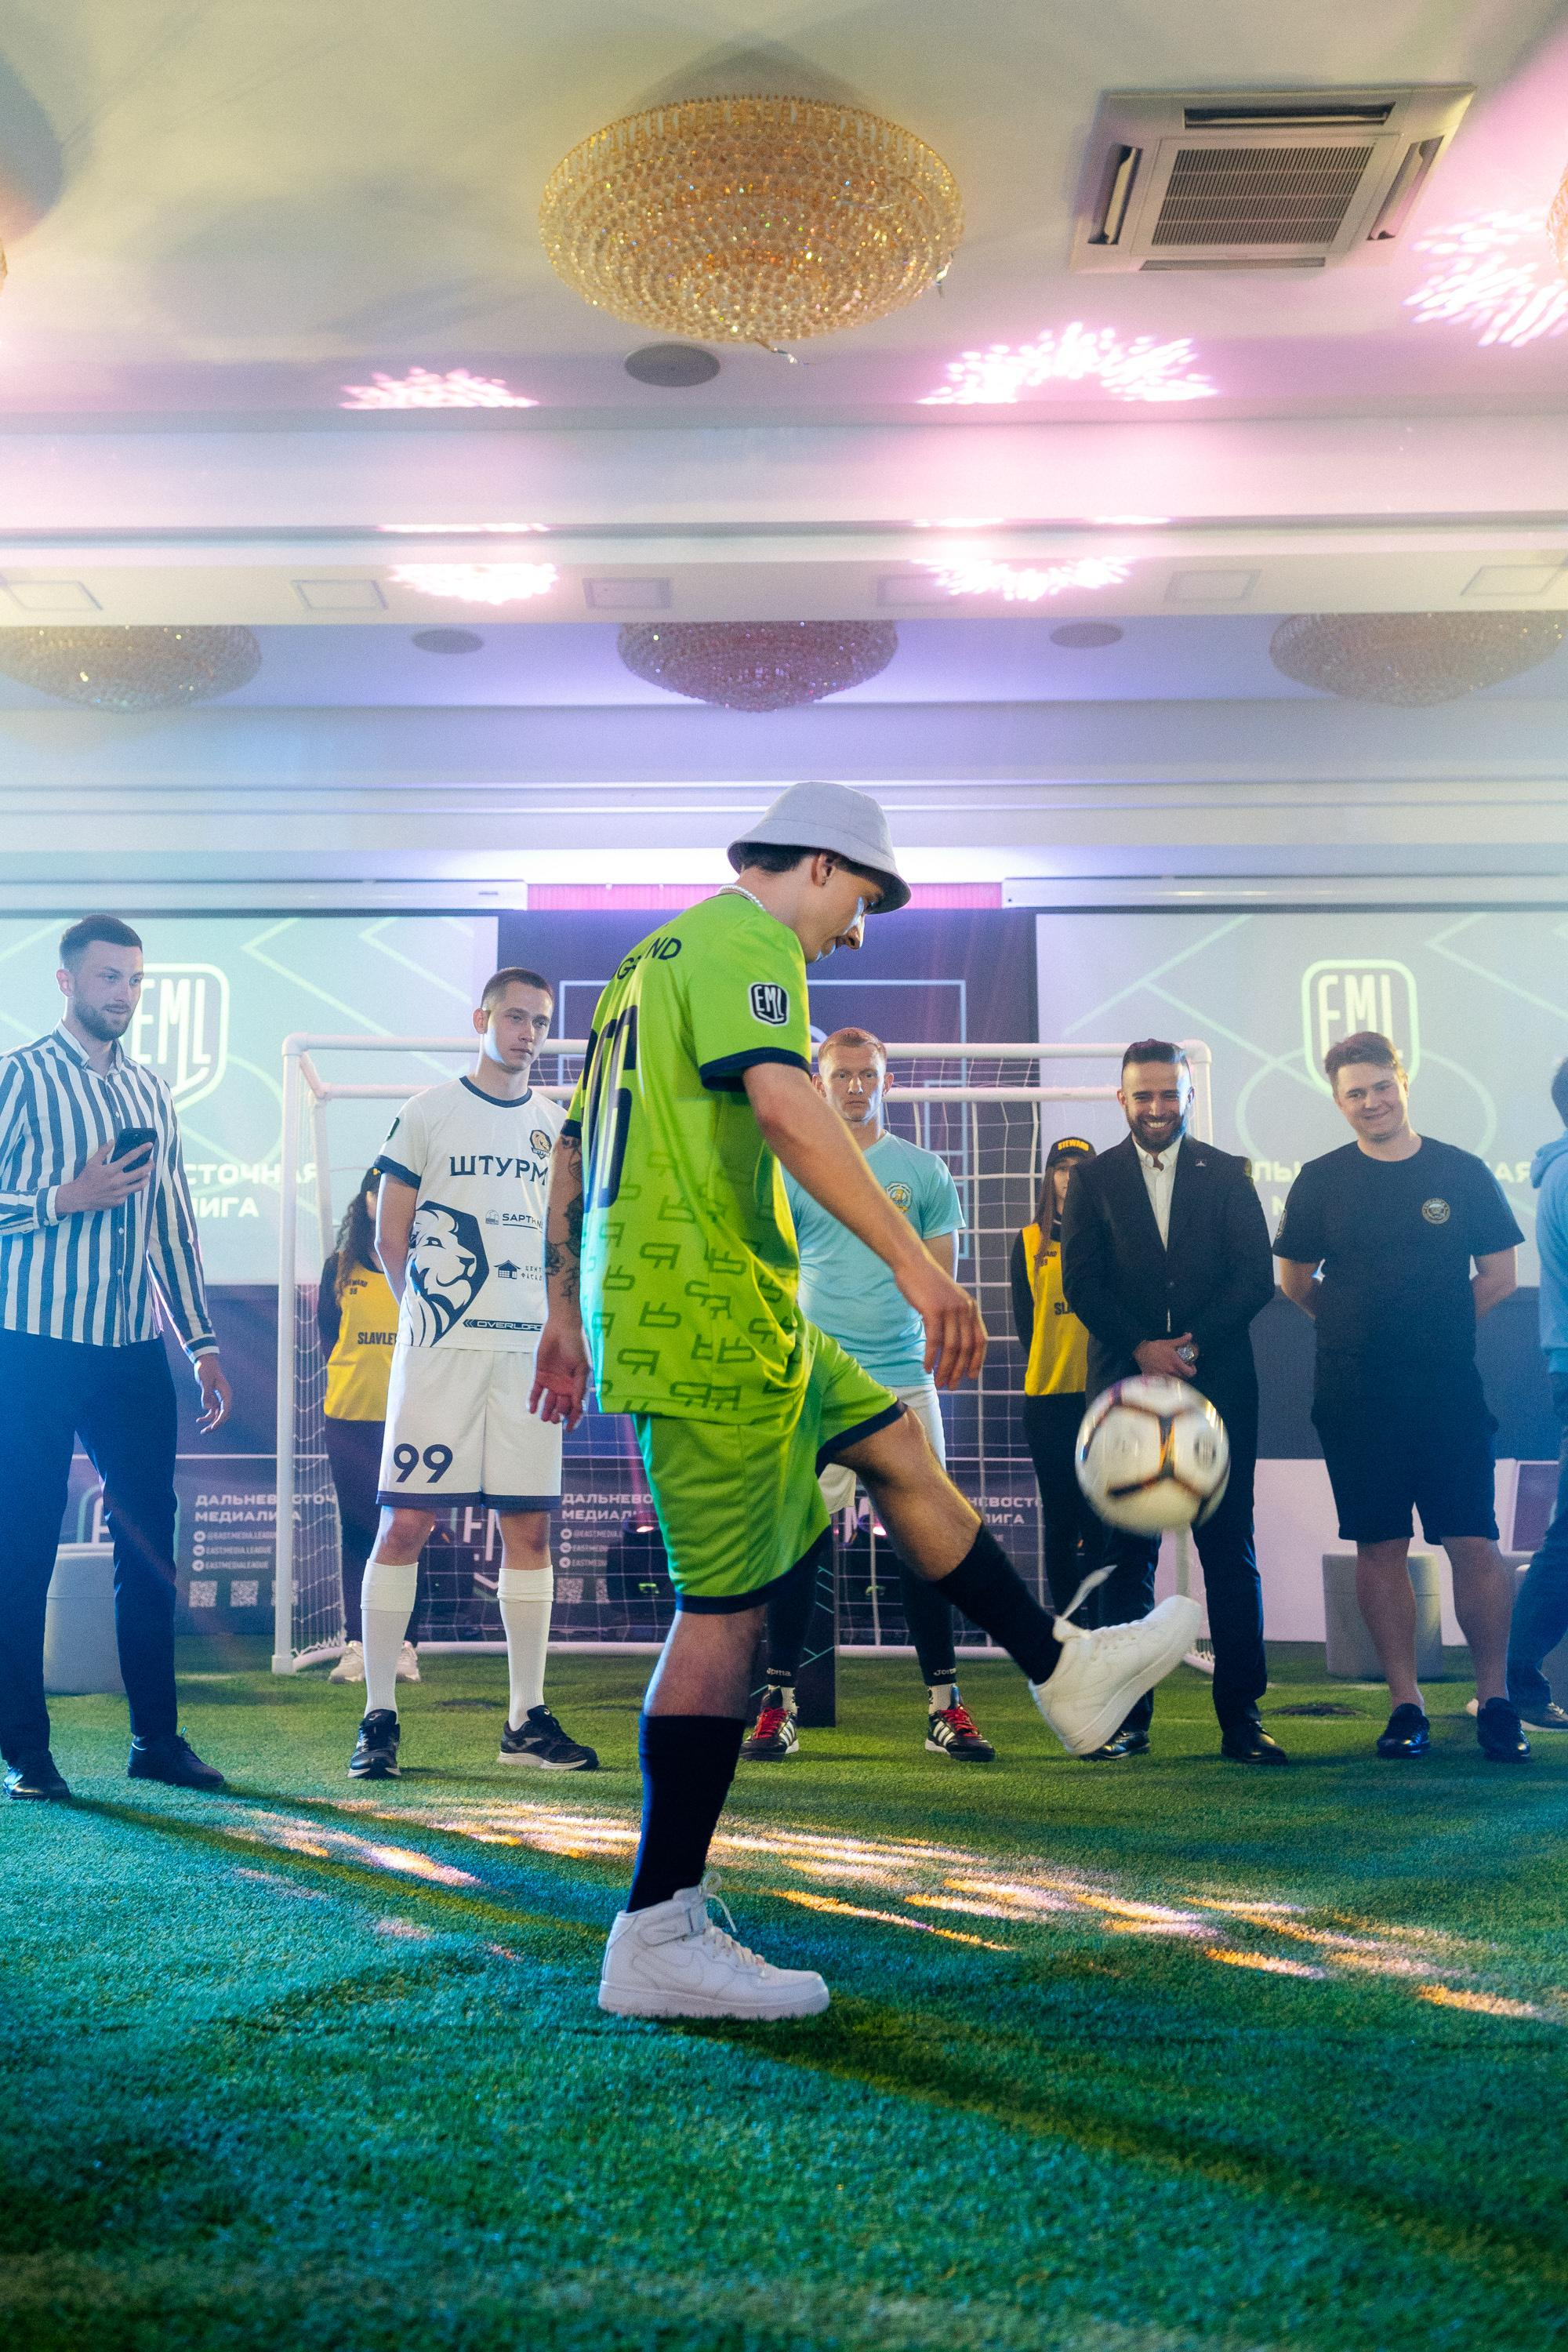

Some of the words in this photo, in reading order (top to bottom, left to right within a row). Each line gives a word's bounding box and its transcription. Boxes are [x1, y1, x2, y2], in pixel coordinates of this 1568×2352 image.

[753, 985, 785, 1022] EML
[183, 1163, 318, 1185] СТОЧНЯ
[449, 1155, 549, 1186] ШТУРМ
[393, 1443, 454, 1483] 99
[195, 1511, 301, 1523] МЕДИАЛИА
[561, 1510, 636, 1522] МЕДИАЛ
[766, 1668, 792, 1677] Joma
